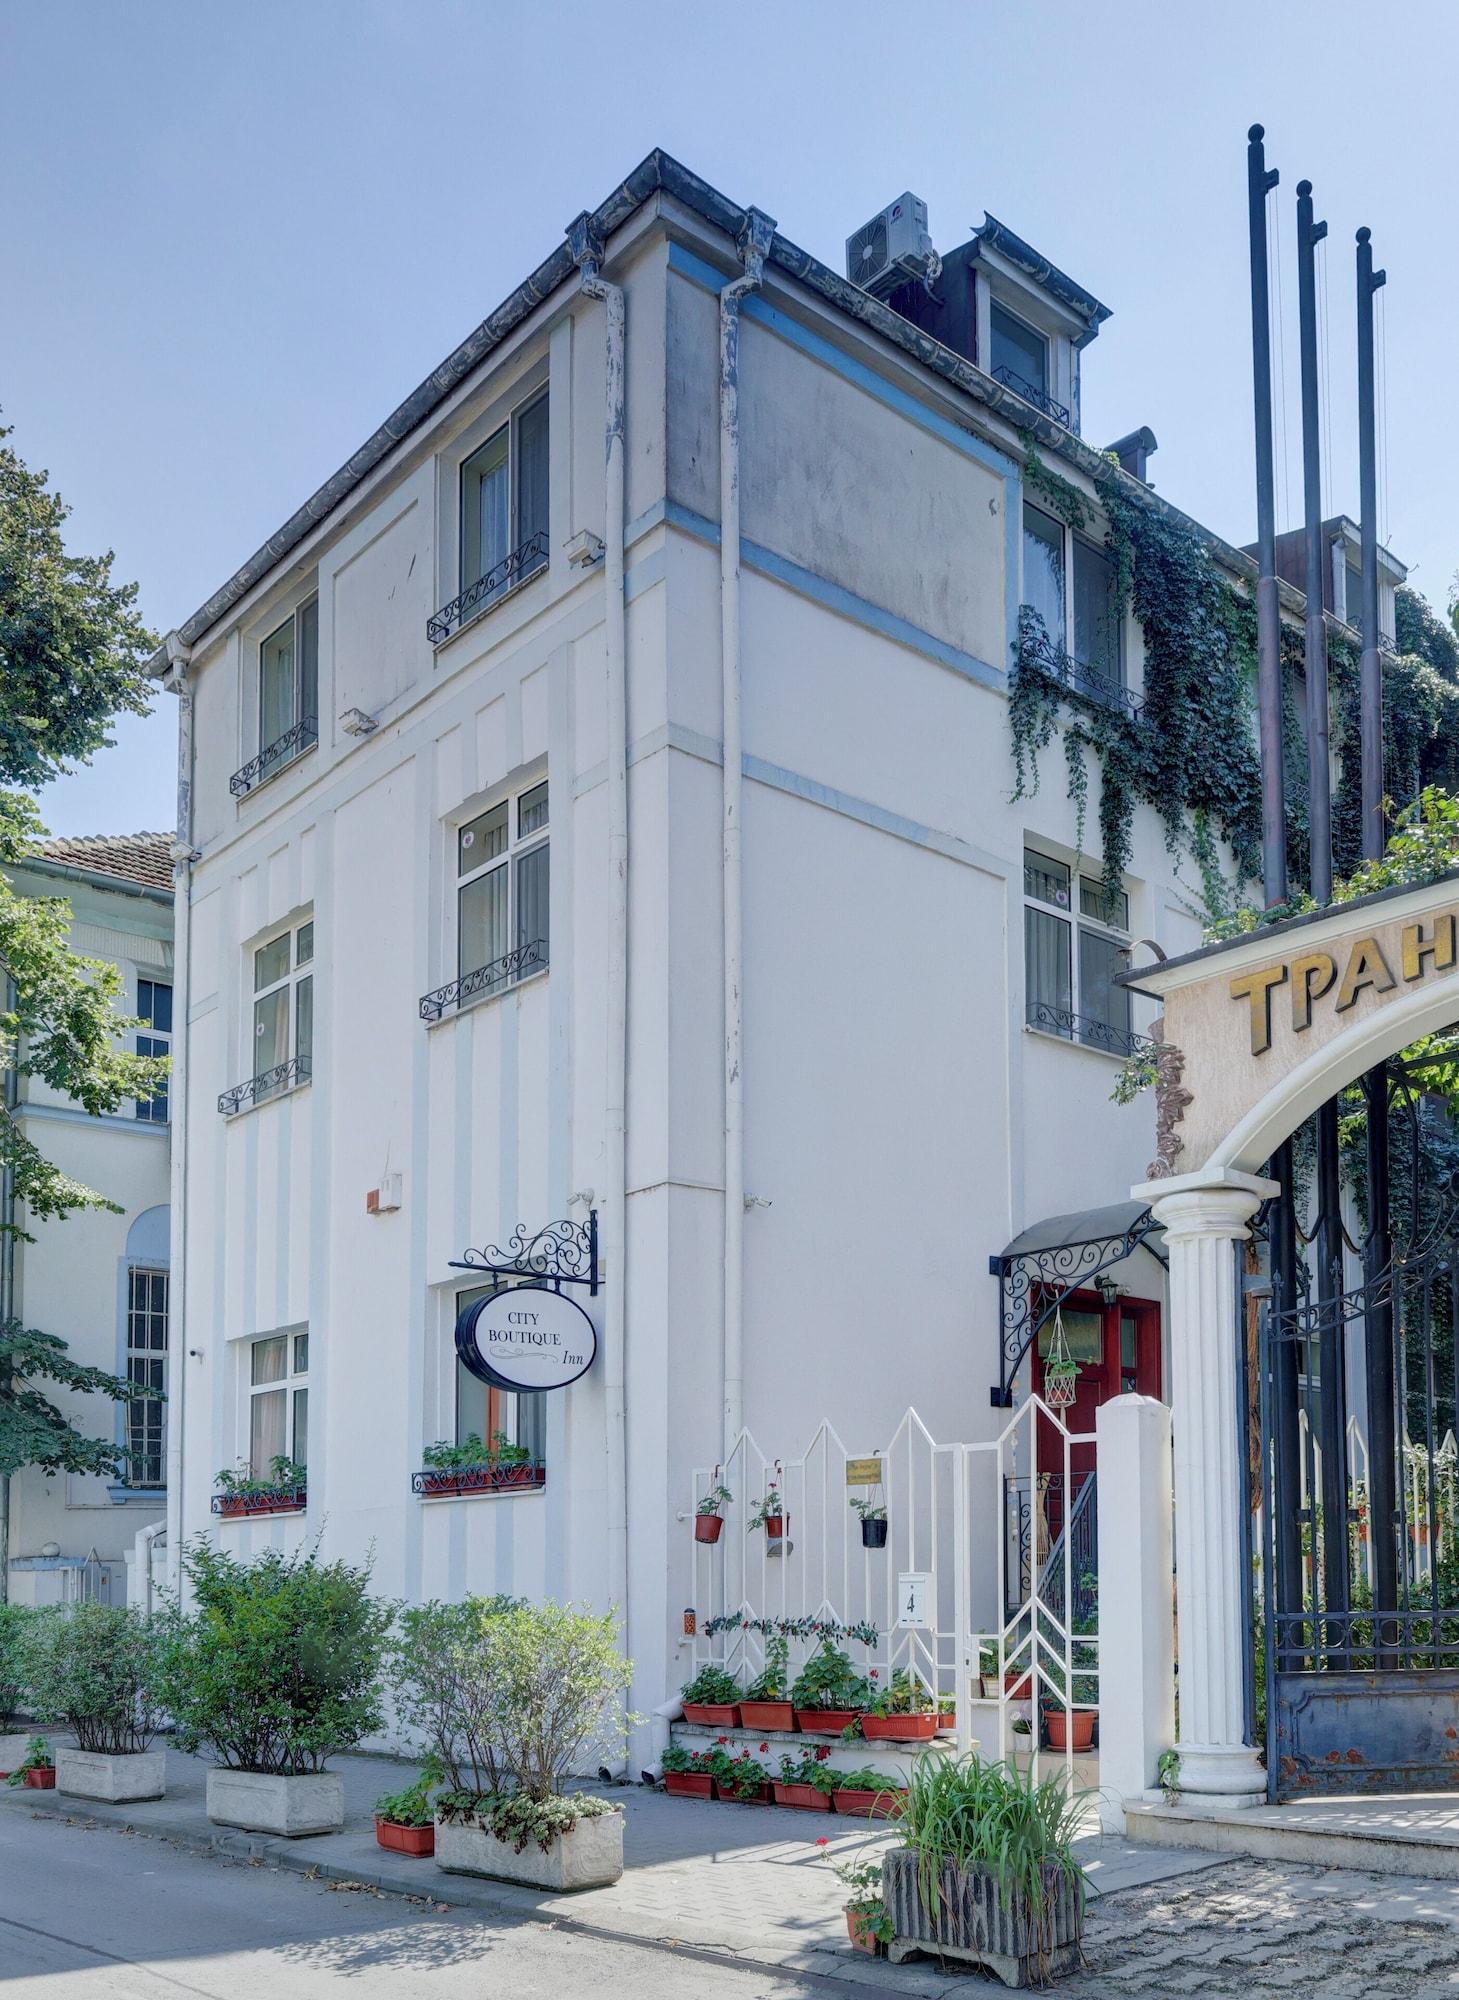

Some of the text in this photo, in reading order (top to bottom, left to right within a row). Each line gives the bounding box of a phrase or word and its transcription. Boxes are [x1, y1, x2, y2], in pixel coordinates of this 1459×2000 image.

[508, 1311, 540, 1325] CITY
[488, 1329, 562, 1346] BOUTIQUE
[562, 1350, 584, 1365] Inn
[906, 1593, 915, 1613] 4
